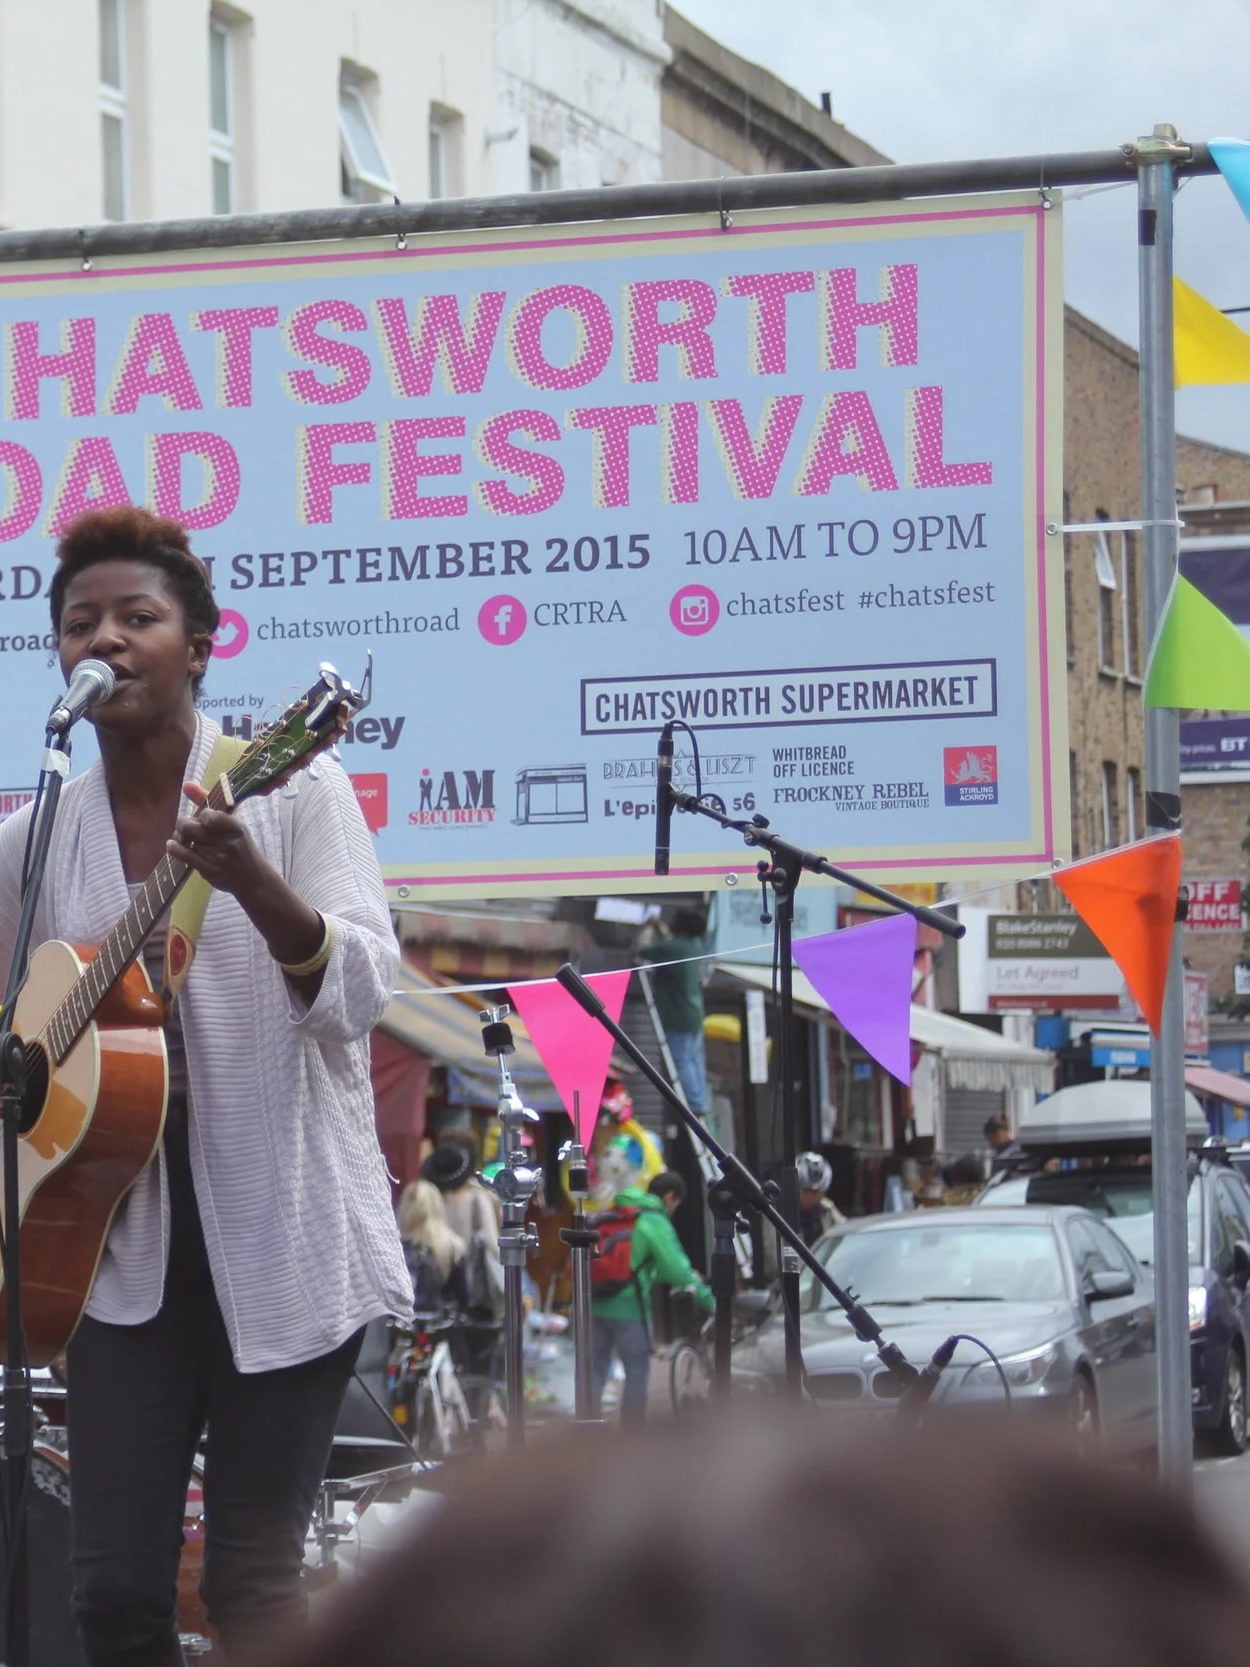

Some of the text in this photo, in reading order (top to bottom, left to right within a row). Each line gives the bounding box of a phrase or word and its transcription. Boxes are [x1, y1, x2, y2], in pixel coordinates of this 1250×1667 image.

[296, 385, 993, 525] FESTIVAL
[230, 538, 532, 591] SEPTEMBER
[545, 533, 651, 574] 2015
[683, 524, 807, 566] 10AM
[817, 519, 879, 558] TO
[892, 513, 988, 555] 9PM
[726, 580, 996, 617] chatsfest #chatsfest
[534, 600, 628, 627] CRTRA
[257, 608, 461, 641] chatsworthroad
[249, 694, 265, 709] by
[594, 675, 979, 724] CHATSWORTH SUPERMARKET
[772, 745, 847, 762] WHITBREAD
[1221, 737, 1248, 752] BT
[603, 759, 683, 780] BRAHS
[706, 756, 756, 776] LISZT
[773, 761, 855, 778] OFF LICENCE
[774, 782, 929, 803] FROCKNEY REBEL
[960, 786, 994, 795] STIRLING
[960, 793, 994, 802] ACKROYD
[732, 792, 756, 812] 56
[835, 798, 930, 812] VINTAGE BOUTIQUE
[408, 808, 498, 825] SECURITY
[997, 966, 1080, 982] Let Agreed
